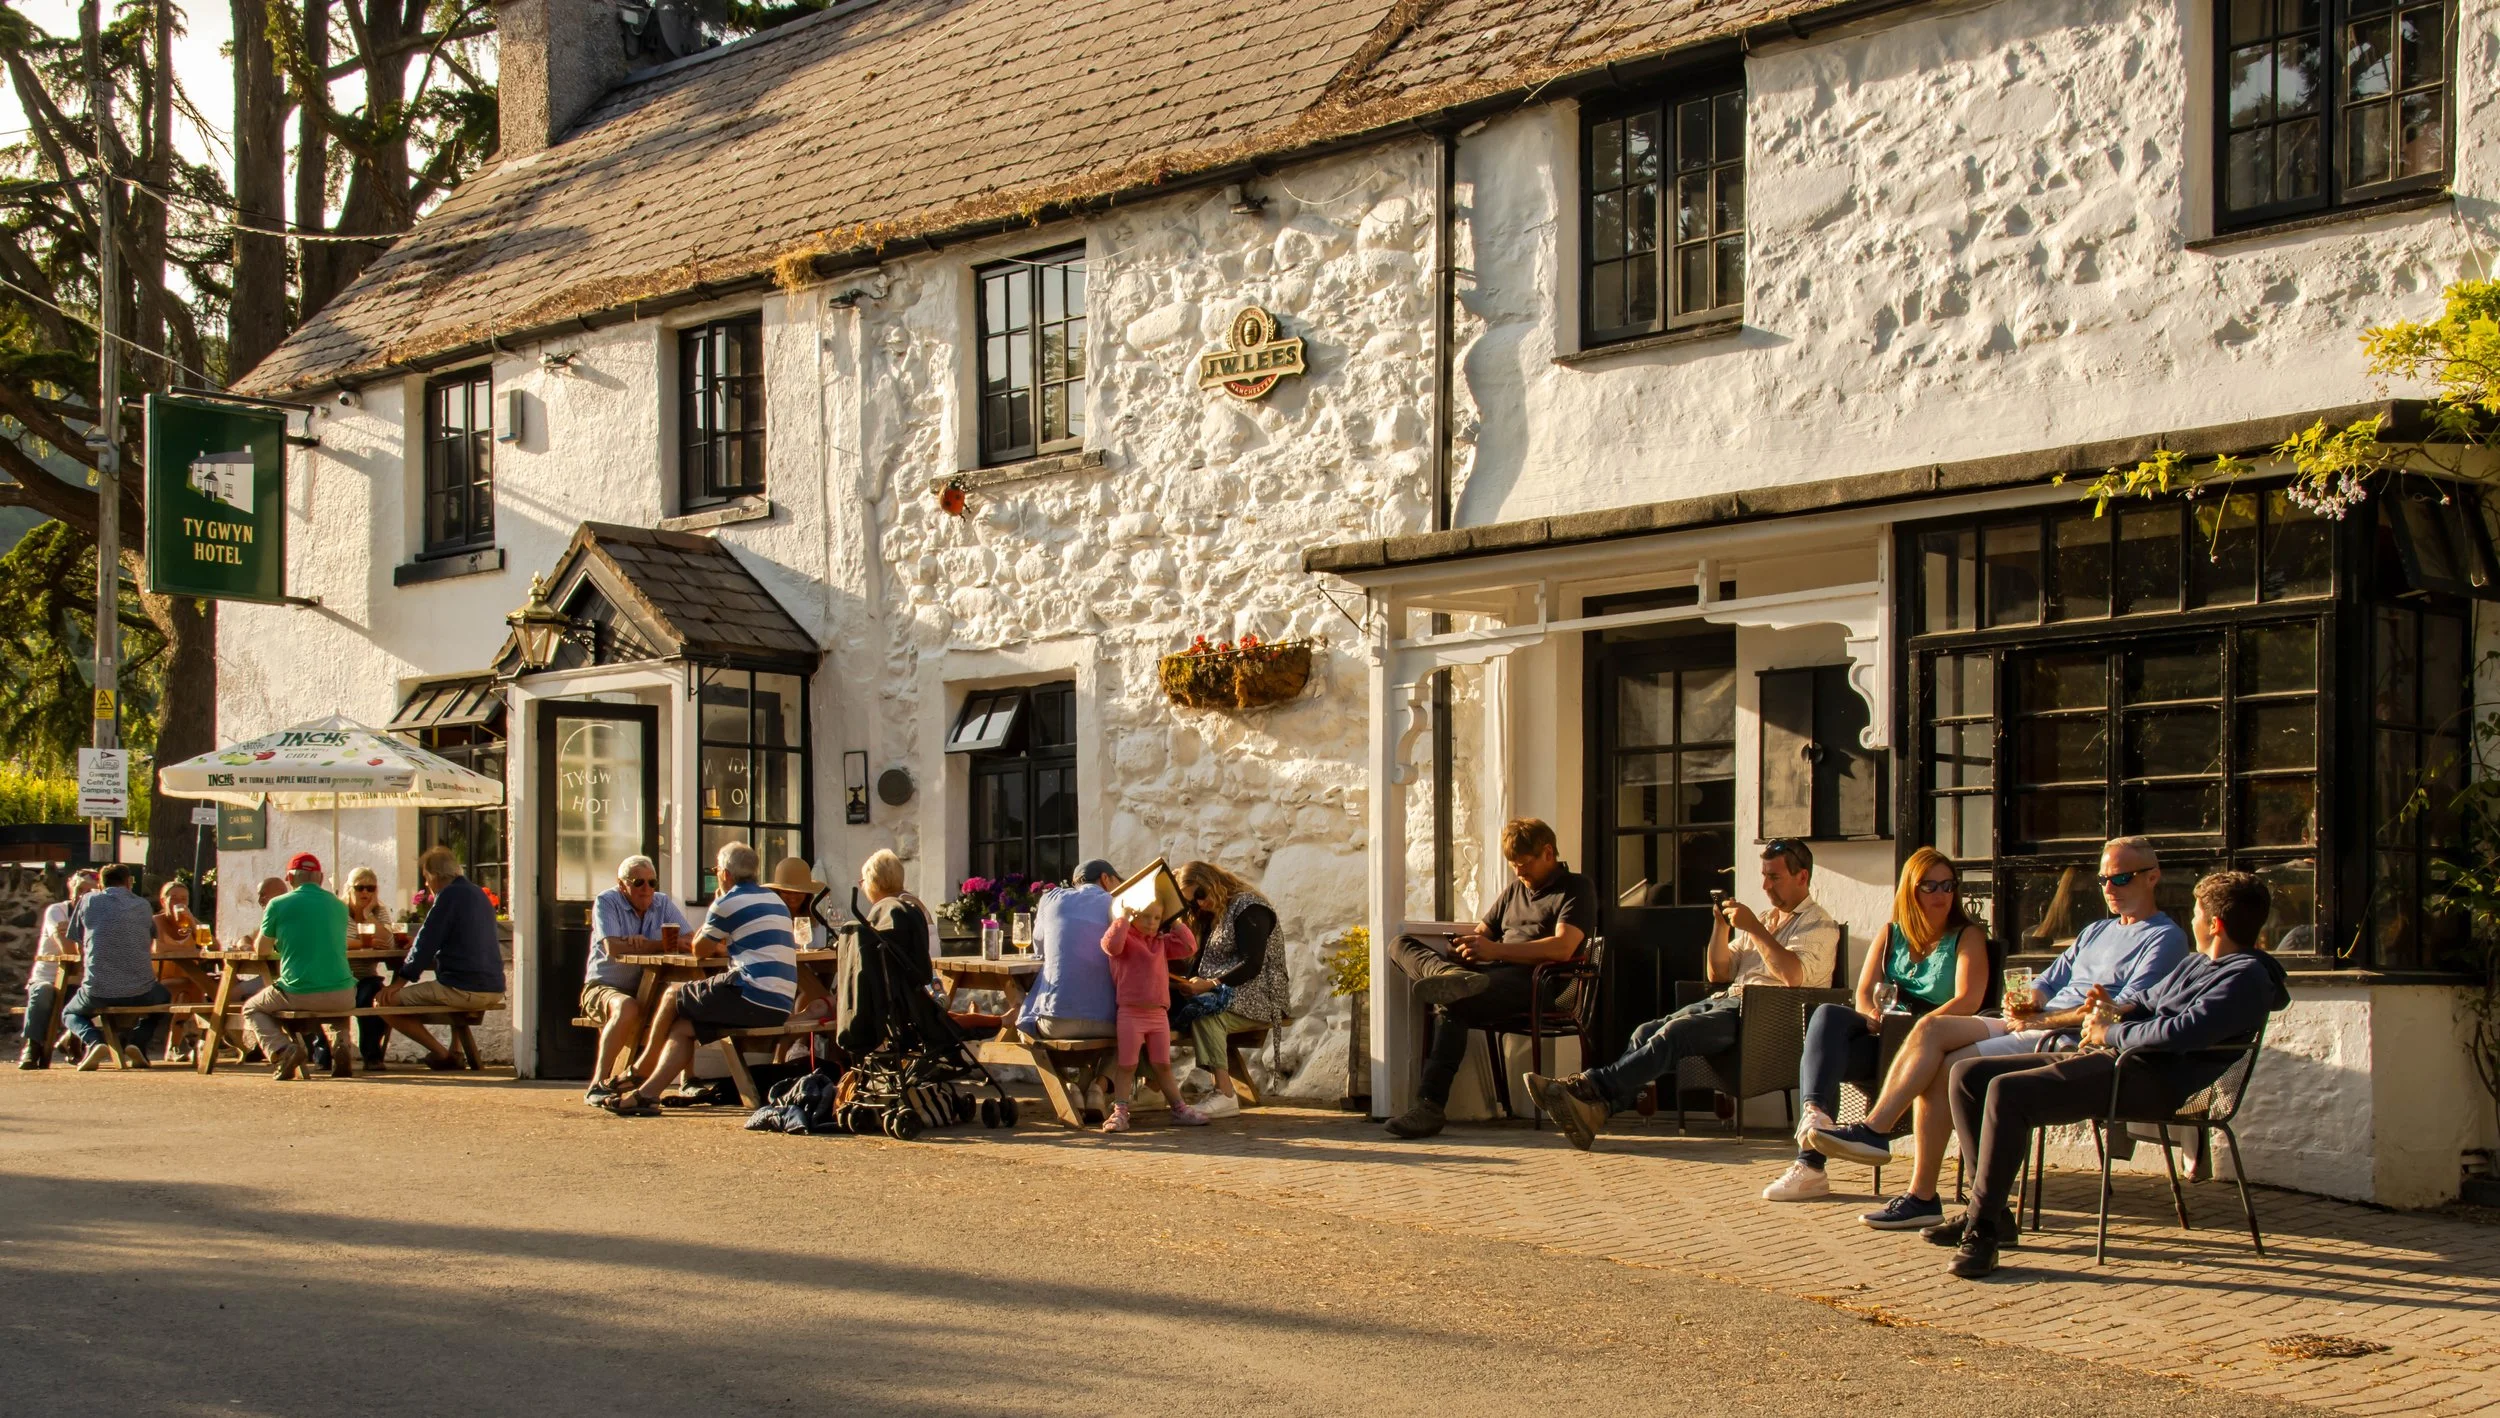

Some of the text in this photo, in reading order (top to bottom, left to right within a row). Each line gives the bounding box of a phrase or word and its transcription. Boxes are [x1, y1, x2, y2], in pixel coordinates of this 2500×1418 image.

[1230, 376, 1274, 395] MANCHESTER
[183, 517, 253, 543] TY GWYN
[194, 542, 242, 565] HOTEL
[239, 776, 248, 784] WE
[249, 776, 264, 784] TURN
[264, 776, 275, 785] ALL
[275, 776, 296, 784] APPLE
[296, 775, 317, 784] WASTE
[572, 796, 630, 815] HOTL
[93, 822, 109, 842] H
